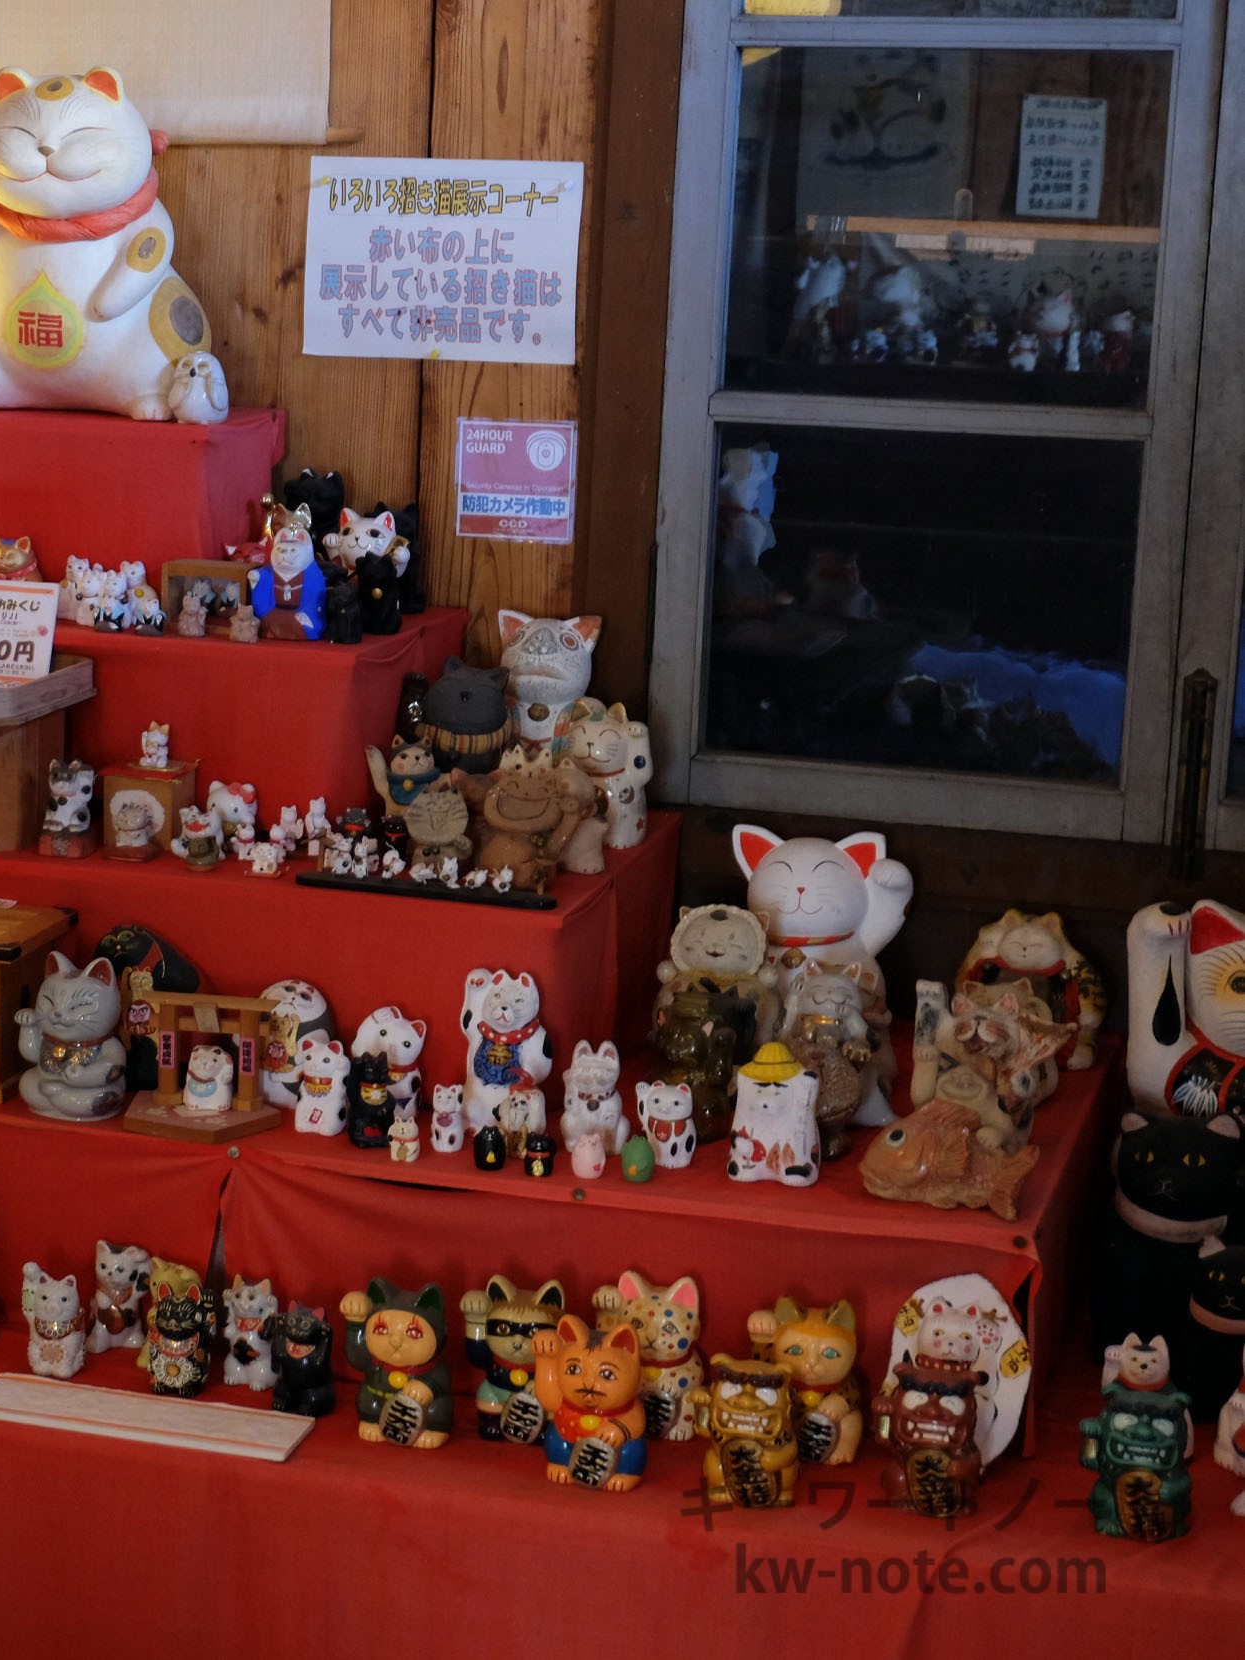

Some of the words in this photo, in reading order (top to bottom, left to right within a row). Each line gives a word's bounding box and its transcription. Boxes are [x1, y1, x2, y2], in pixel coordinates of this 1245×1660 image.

[329, 177, 559, 217] いろいろ招き猫展示コーナー
[369, 226, 514, 264] 赤い布の上に
[319, 264, 562, 306] 展示している招き猫は
[18, 311, 63, 348] 福
[338, 304, 541, 345] すべて非売品です。
[466, 429, 513, 442] 24HOUR
[466, 442, 506, 455] GUARD
[462, 495, 566, 516] 防犯カメラ作動中
